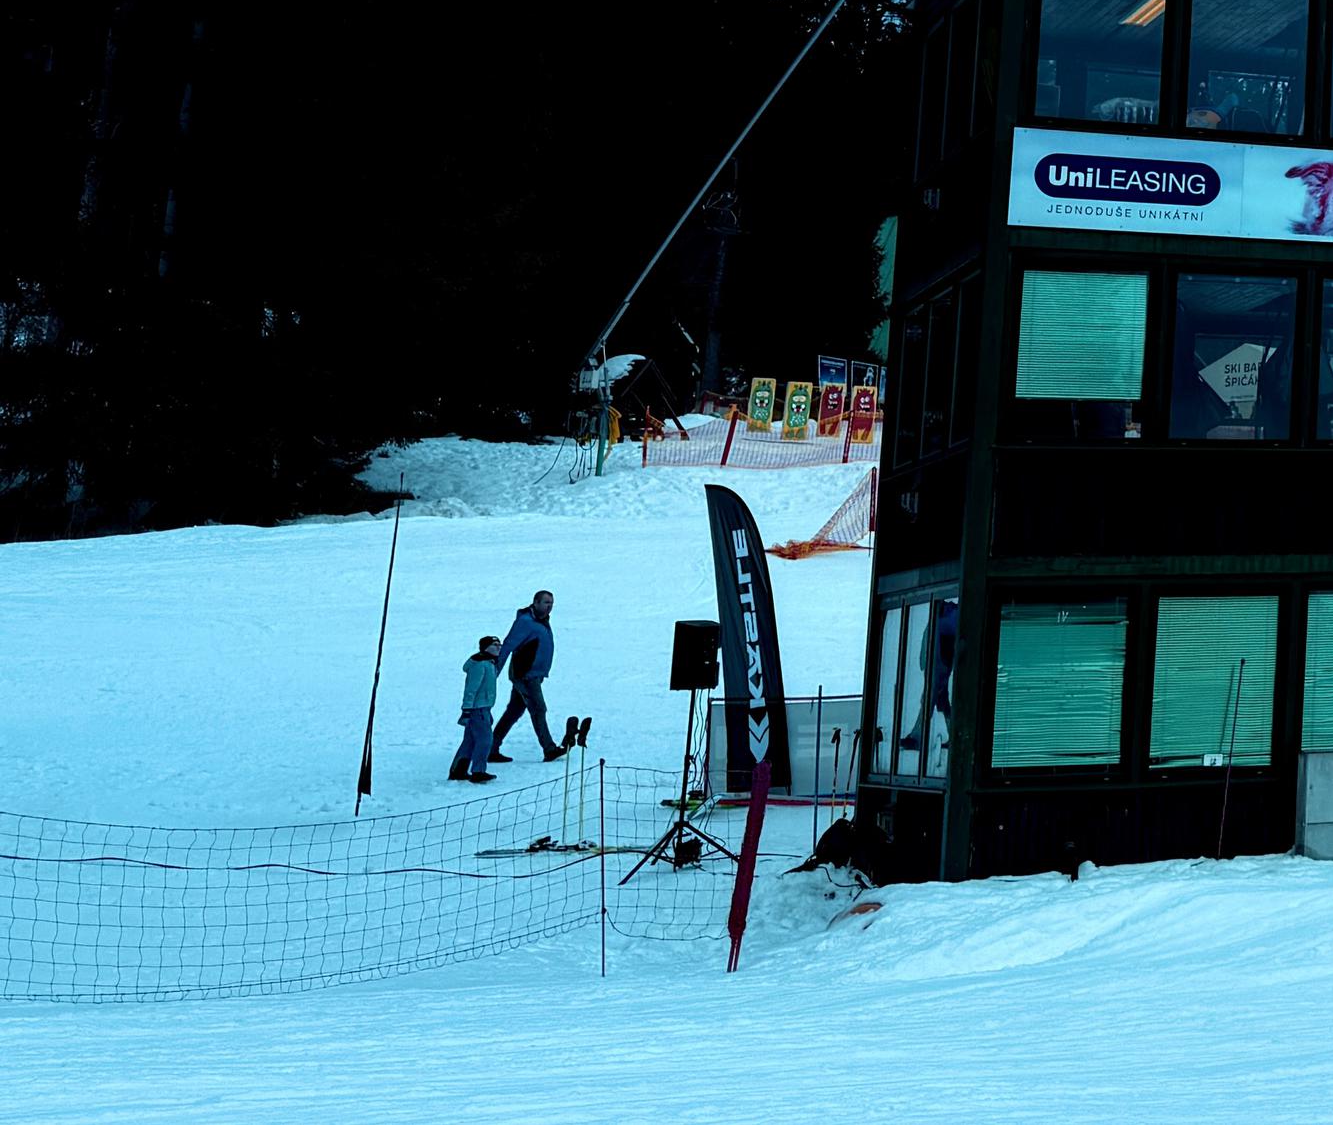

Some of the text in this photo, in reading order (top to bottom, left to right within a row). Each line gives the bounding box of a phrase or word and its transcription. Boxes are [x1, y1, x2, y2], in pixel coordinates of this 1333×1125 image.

[1048, 164, 1207, 195] UniLEASING
[1046, 204, 1204, 221] JEDNODUŠE UNIKÁTNÍ
[1224, 363, 1259, 374] SKI BA
